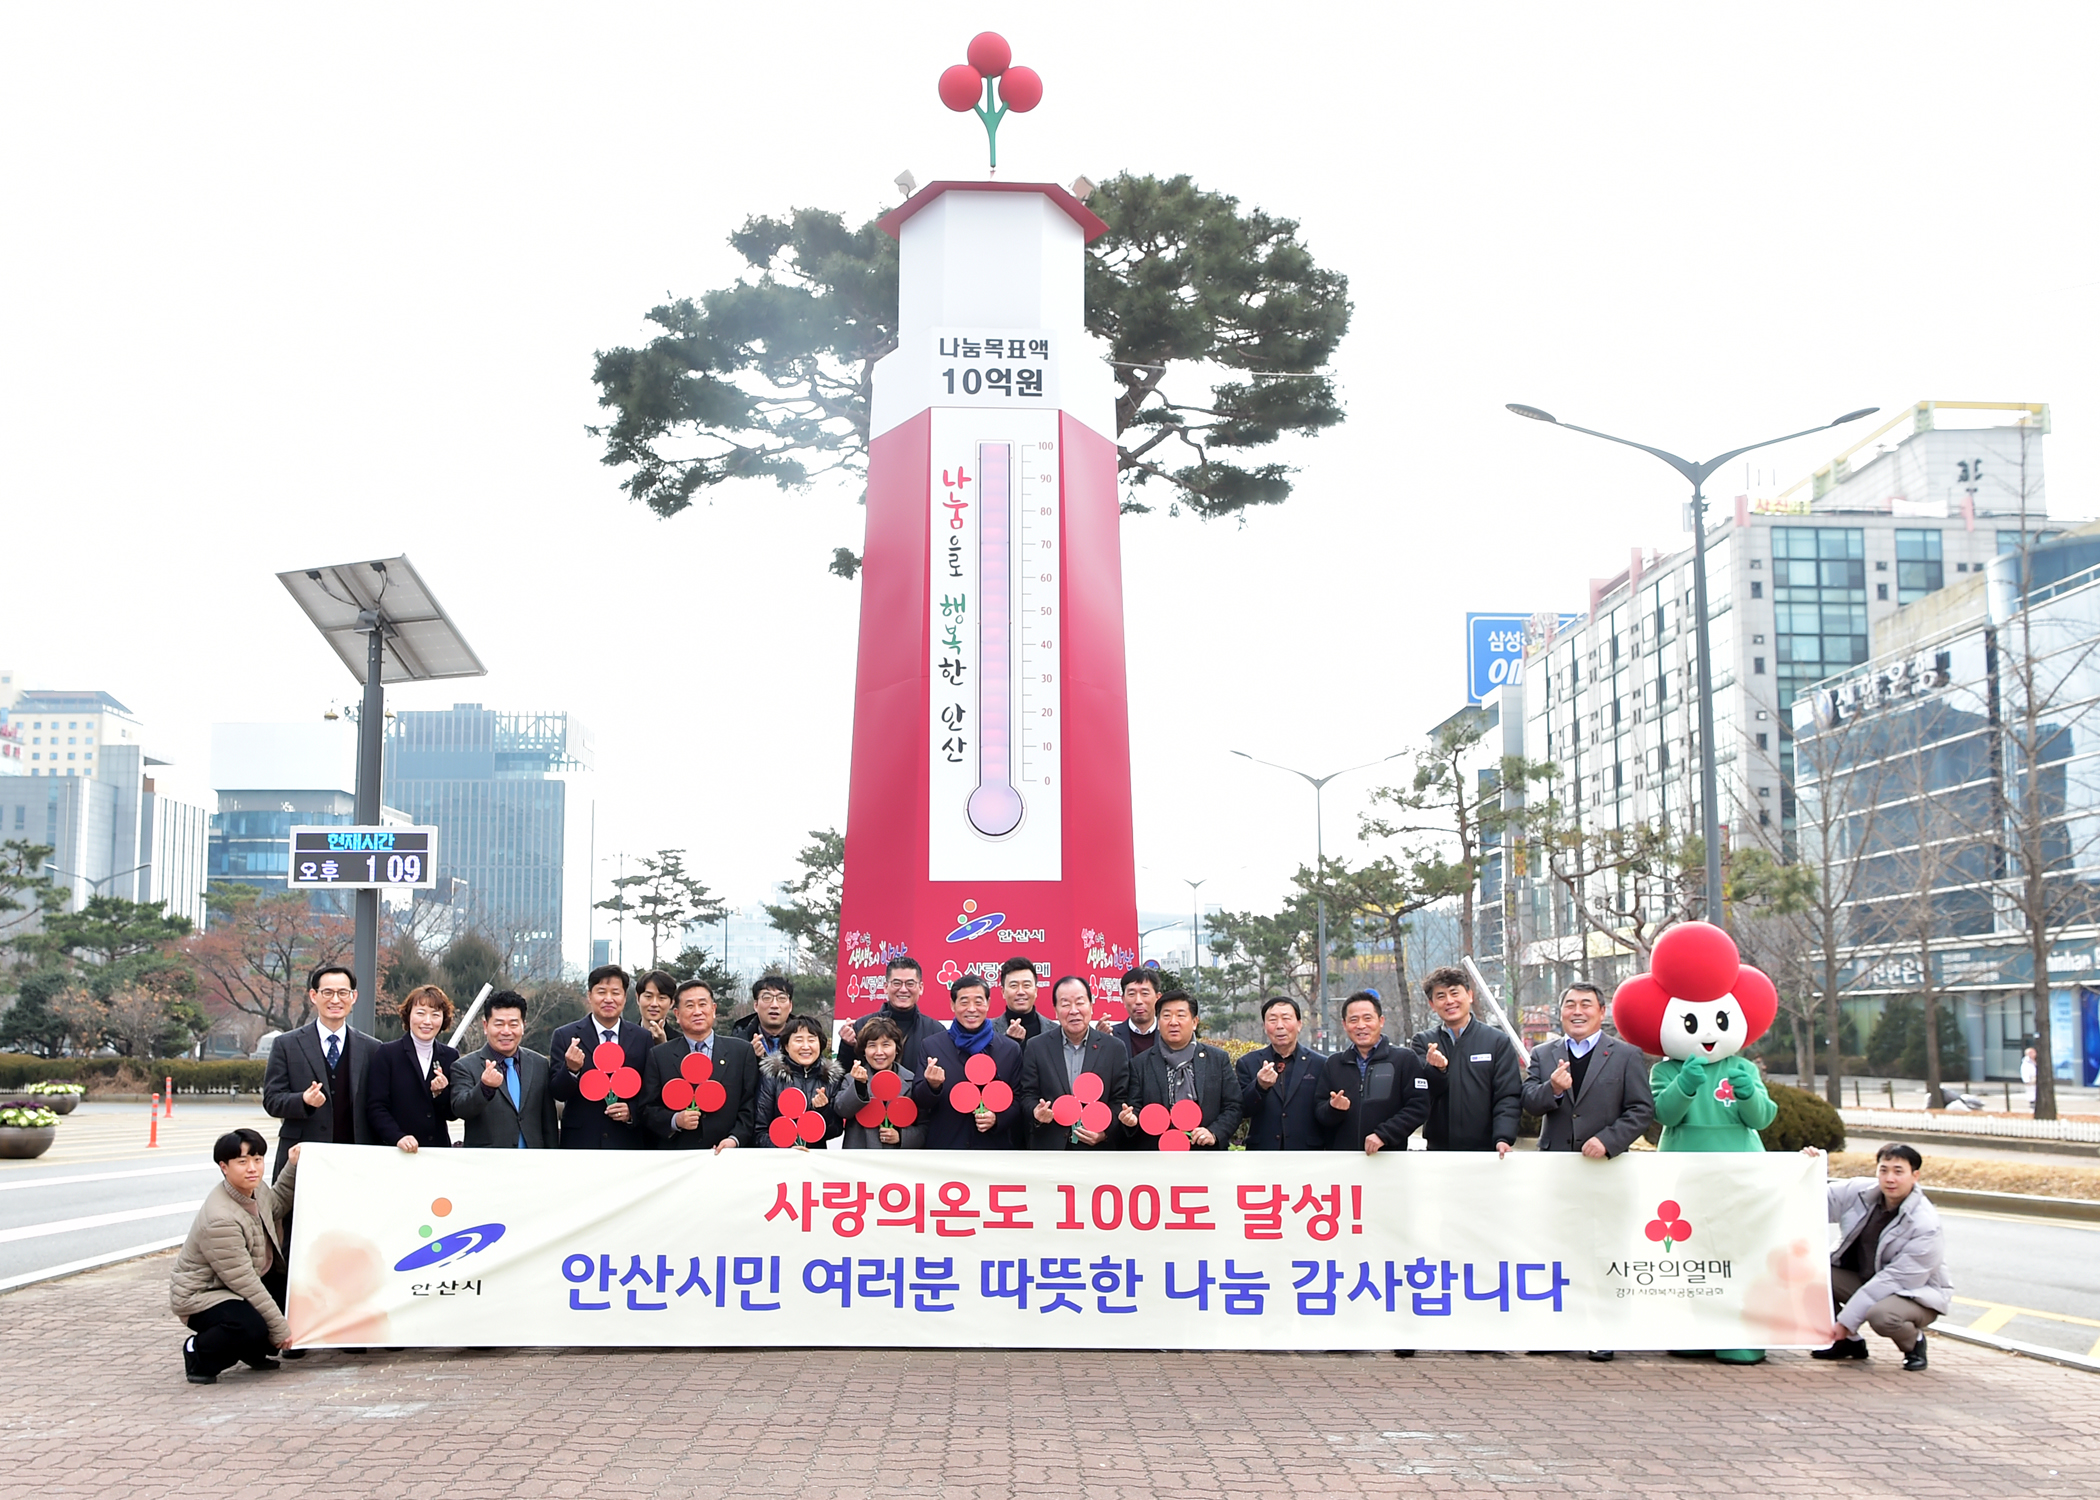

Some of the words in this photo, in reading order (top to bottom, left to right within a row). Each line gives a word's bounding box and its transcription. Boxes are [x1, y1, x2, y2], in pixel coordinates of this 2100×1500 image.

[939, 337, 1049, 361] 나눔목표액
[942, 368, 1043, 397] 10억원
[1038, 441, 1053, 451] 100
[1040, 474, 1052, 483] 90
[1040, 507, 1052, 516] 80
[942, 466, 972, 577] 나눔으로
[1040, 540, 1052, 549] 70
[1040, 573, 1052, 582] 60
[1040, 606, 1052, 615] 50
[938, 593, 967, 686] 행복한
[1041, 640, 1052, 649] 40
[1041, 674, 1052, 683] 30
[1041, 707, 1053, 716] 20
[941, 703, 967, 762] 안산
[1042, 742, 1052, 751] 10
[1044, 776, 1051, 785] 0
[327, 832, 396, 851] 현재시간
[298, 859, 340, 882] 오후
[366, 855, 376, 882] 1
[386, 855, 421, 882] 09
[997, 928, 1045, 943] 안산시
[964, 961, 1051, 981] 사랑매
[764, 1181, 1034, 1238] 사랑의온도
[1056, 1184, 1216, 1231] 100도
[1236, 1183, 1363, 1242] 달성!
[1606, 1259, 1732, 1286] 사랑의열매
[411, 1279, 482, 1296] 안산시
[561, 1253, 781, 1312] 안산시민
[802, 1256, 960, 1313] 여러분
[980, 1255, 1144, 1315] 따뜻한
[1165, 1259, 1271, 1316] 나눔
[1292, 1256, 1570, 1317] 감사합니다
[1616, 1287, 1635, 1299] 경기
[1639, 1287, 1724, 1299] 사회복지공동모금회
